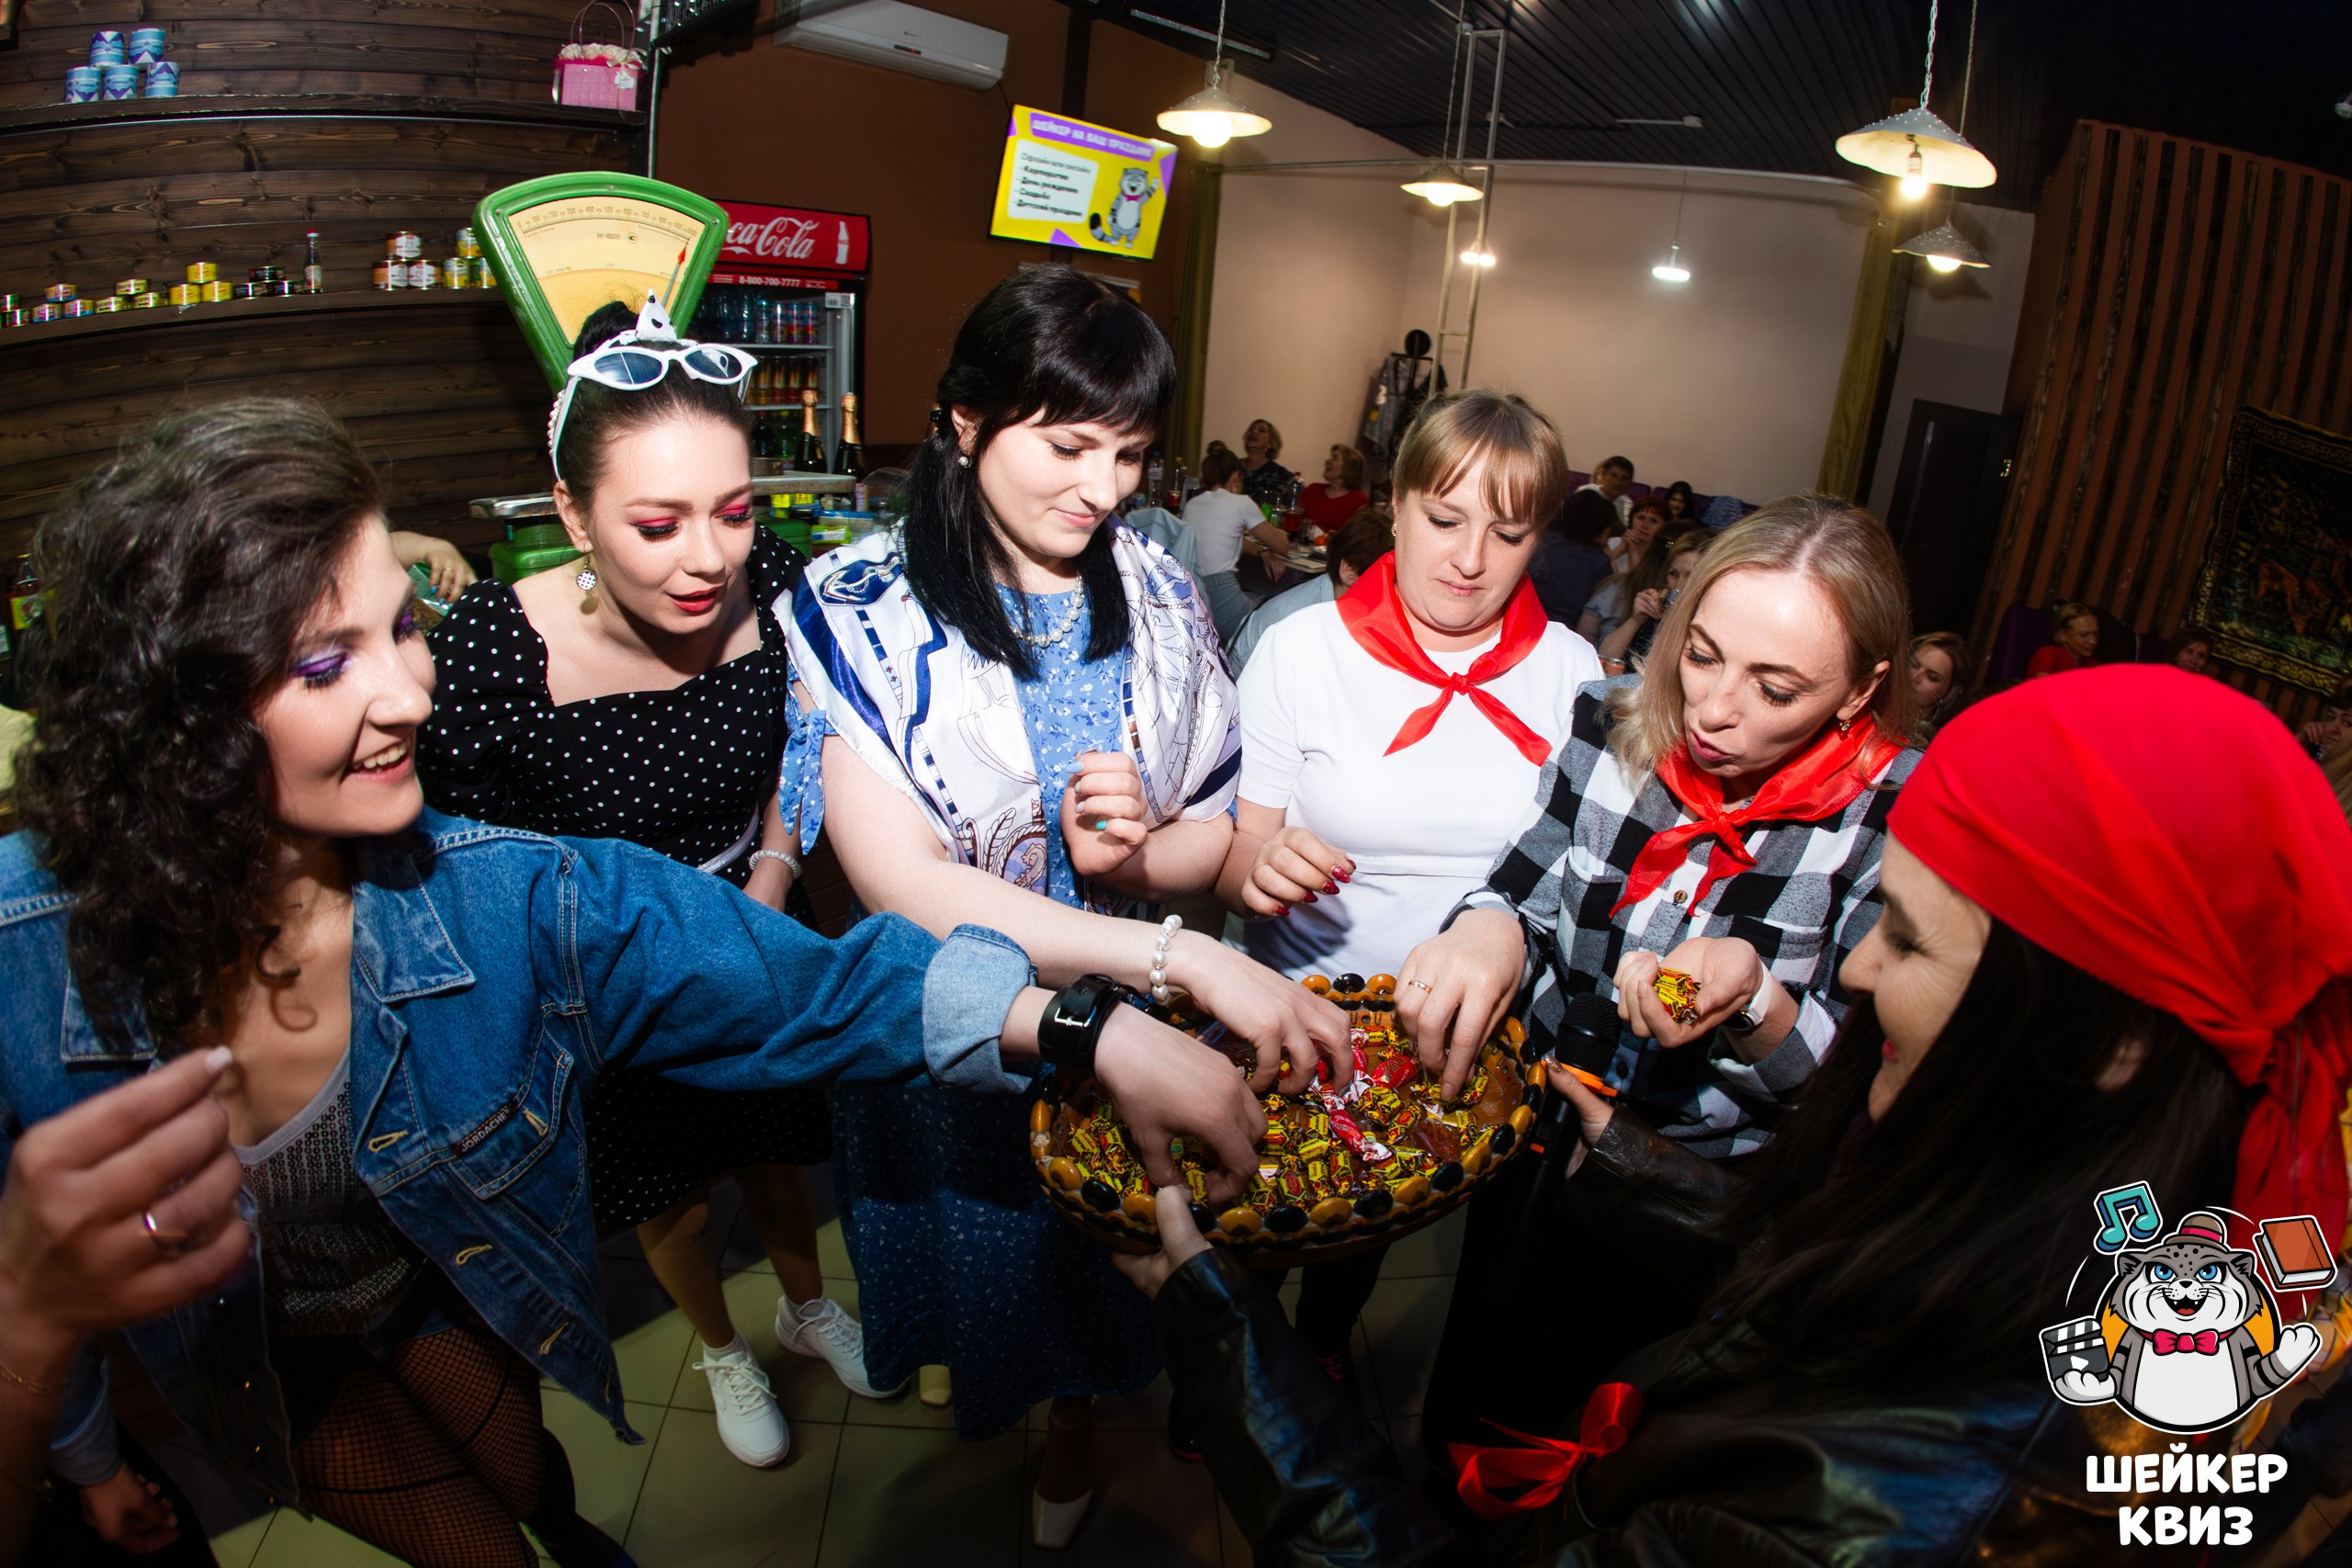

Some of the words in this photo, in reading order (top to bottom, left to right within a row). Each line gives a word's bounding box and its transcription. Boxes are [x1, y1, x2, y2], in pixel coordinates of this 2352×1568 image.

[1032, 119, 1070, 137] ШЕЙКЕР
[1071, 129, 1085, 140] НА
[1086, 132, 1106, 146] ВАШ
[1108, 138, 1153, 157] ПРАЗДНИК
[723, 217, 820, 259] ca-Cola
[739, 276, 801, 287] 8-800-700-7777
